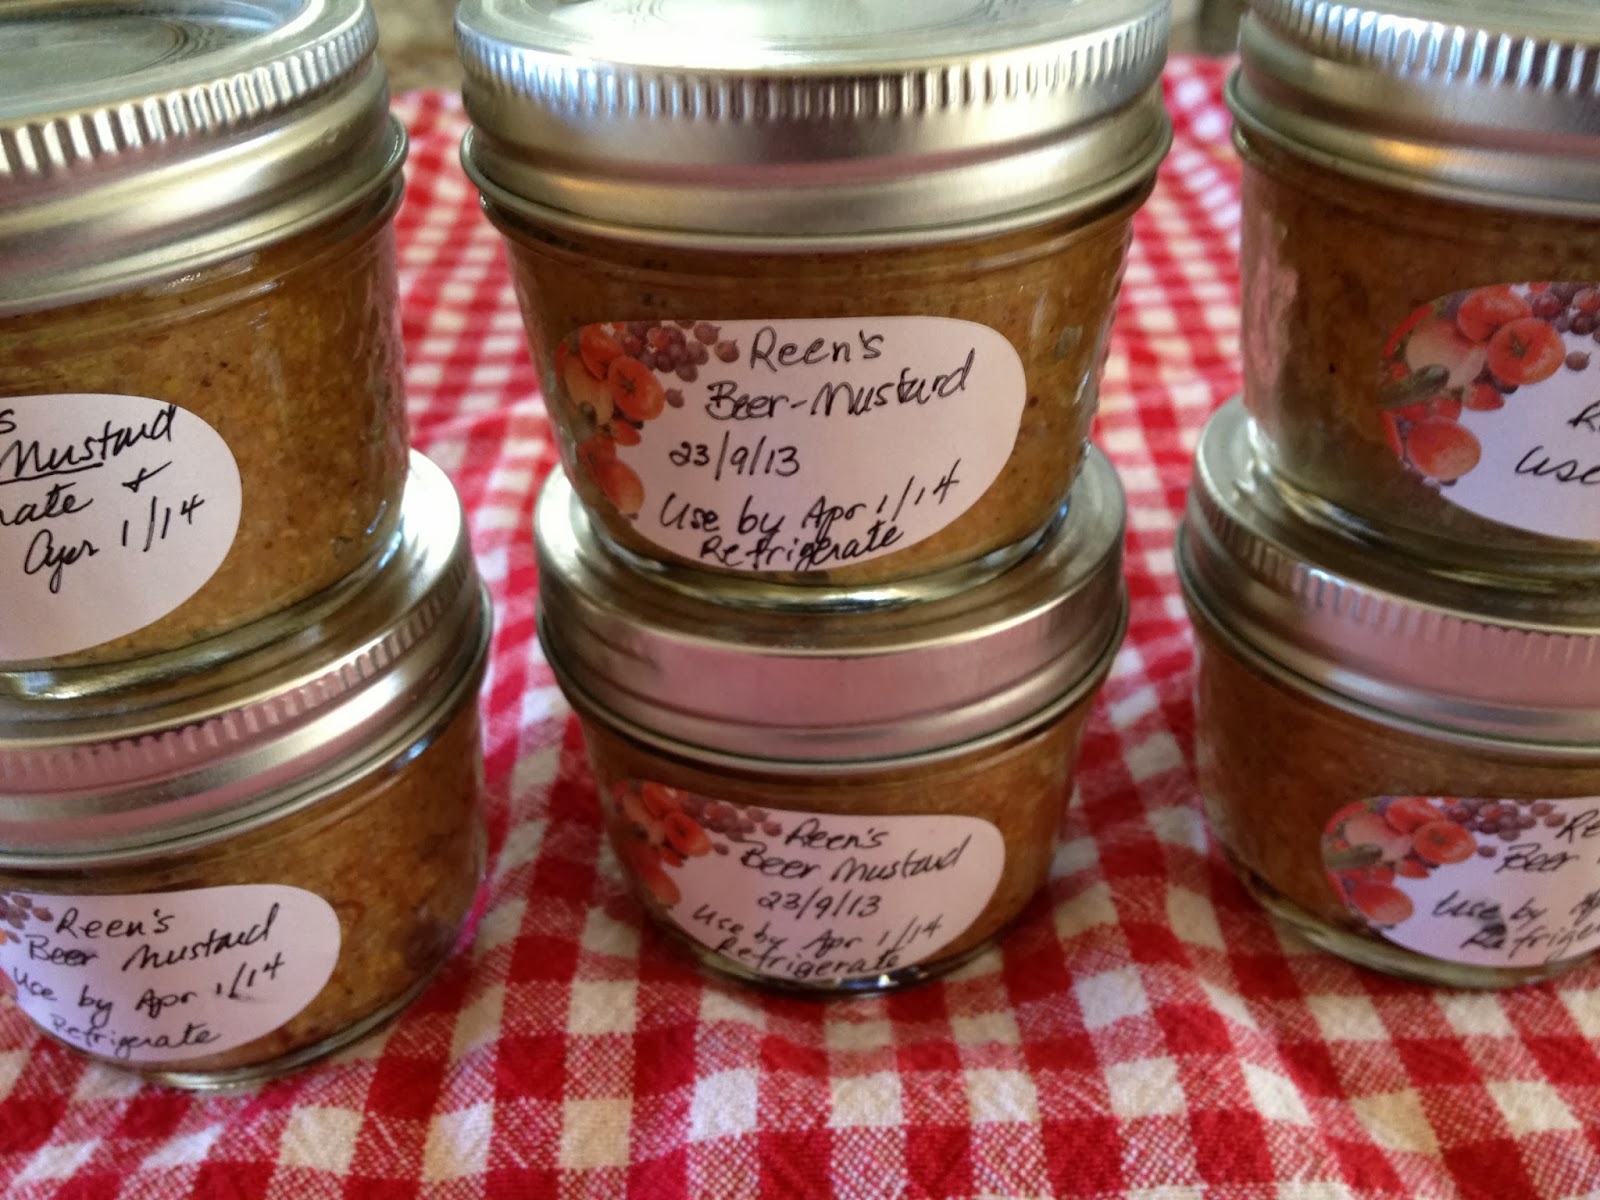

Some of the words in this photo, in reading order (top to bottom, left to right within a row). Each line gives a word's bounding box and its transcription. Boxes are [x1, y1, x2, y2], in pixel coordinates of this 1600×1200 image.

[749, 326, 885, 372] Reen's
[668, 430, 801, 481] 23/9/13
[659, 492, 720, 532] Use
[738, 495, 786, 542] by
[801, 496, 867, 540] Apr
[700, 519, 904, 572] Refrigerate
[785, 817, 889, 850] Reen's
[740, 840, 821, 878] Beer
[757, 887, 883, 920] 23/9/13
[55, 907, 175, 939] Reen's
[753, 921, 787, 949] by
[802, 929, 863, 959] Apr
[25, 934, 98, 967] Beer
[78, 985, 113, 1028] by
[135, 989, 198, 1018] Apr
